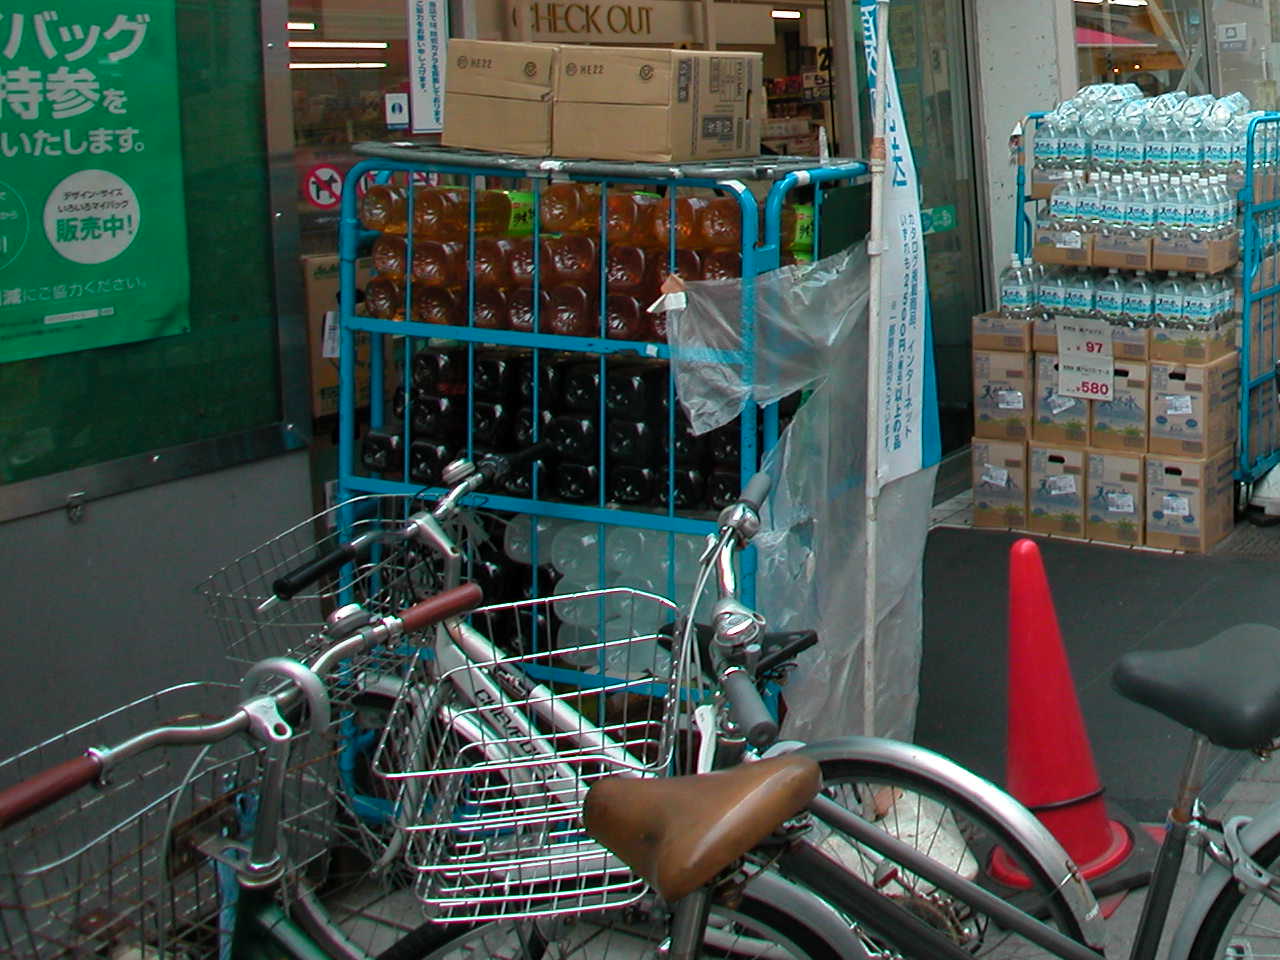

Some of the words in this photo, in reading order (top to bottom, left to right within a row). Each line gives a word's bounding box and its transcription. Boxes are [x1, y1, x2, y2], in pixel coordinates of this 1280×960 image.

[607, 5, 655, 34] OUT
[0, 10, 151, 62] バッグ
[0, 66, 127, 120] 持参を
[2, 127, 145, 158] いたします。
[0, 279, 146, 307] 減にご協力ください。
[1086, 341, 1103, 354] 97
